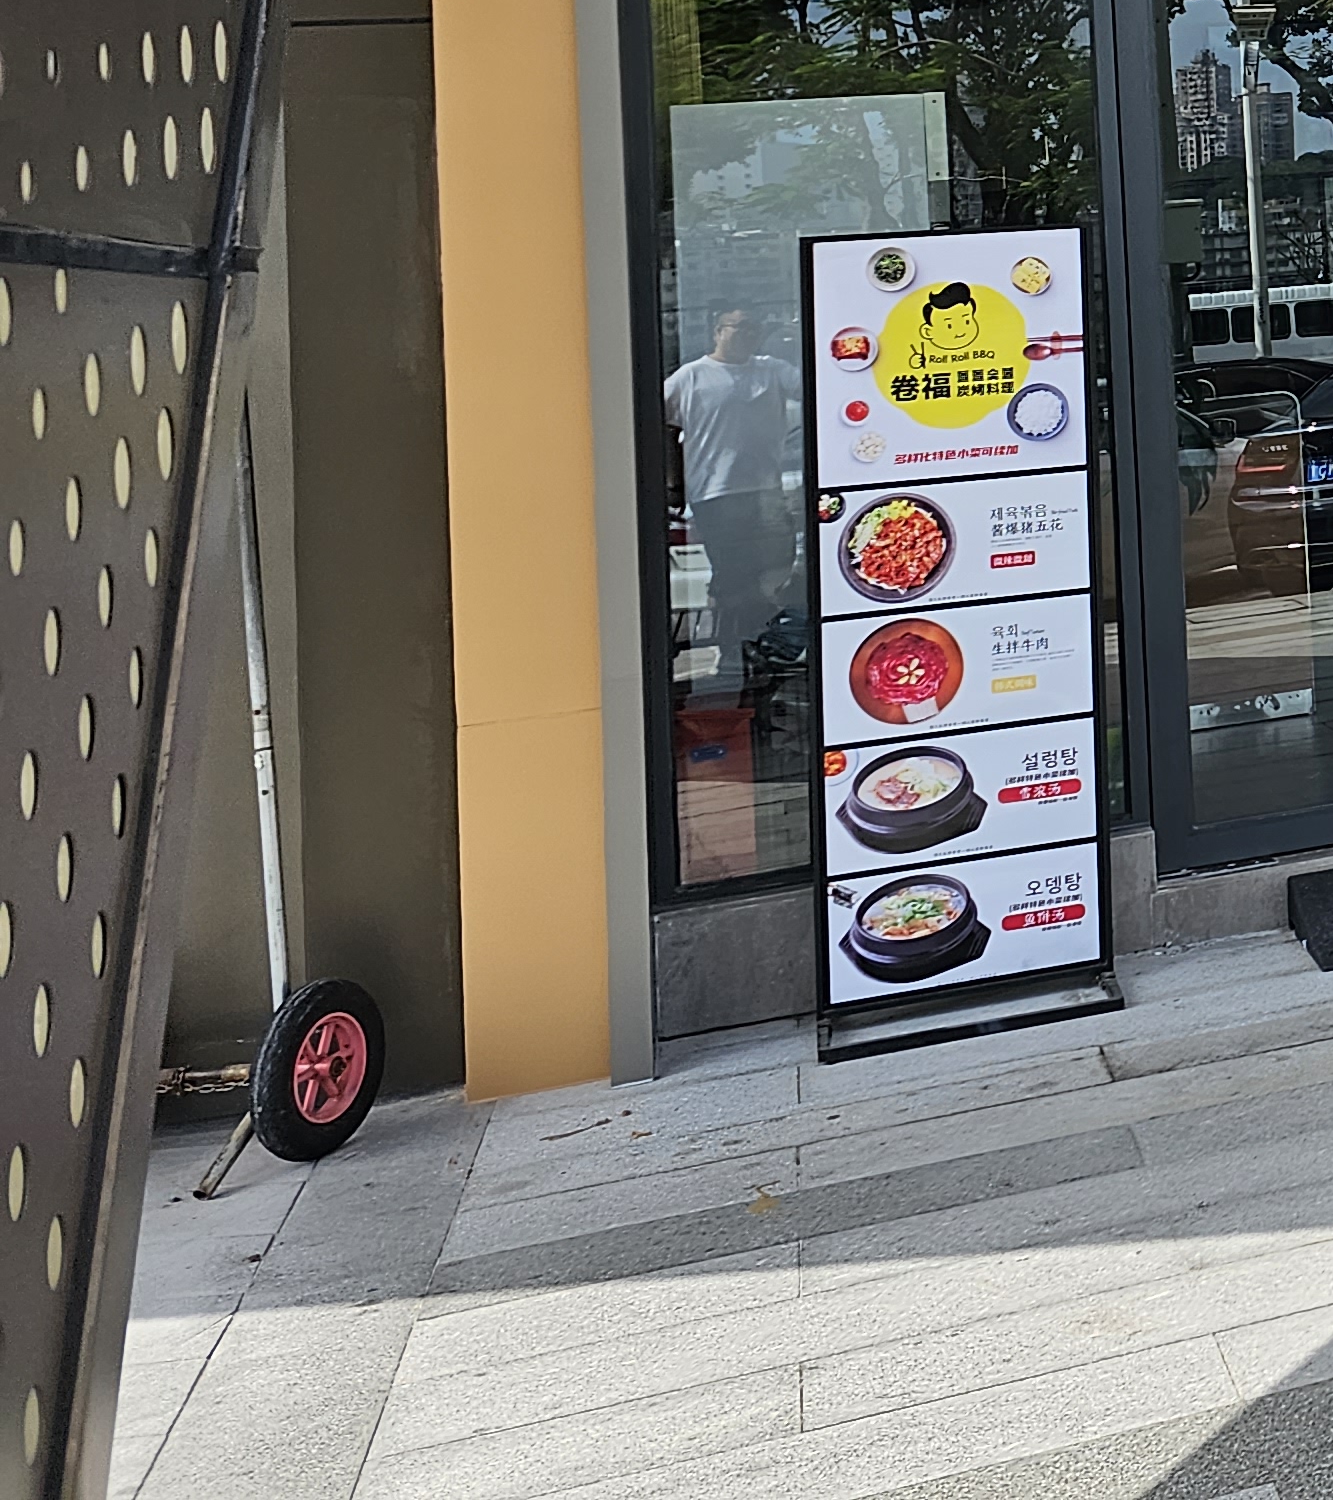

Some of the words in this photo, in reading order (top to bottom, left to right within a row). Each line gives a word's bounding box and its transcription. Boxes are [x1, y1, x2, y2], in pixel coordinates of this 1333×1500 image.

[929, 354, 948, 364] Roll
[951, 352, 969, 363] Roll
[973, 350, 995, 359] BBQ
[891, 372, 951, 402] 卷福
[992, 637, 1049, 656] 生拌牛肉
[1021, 747, 1079, 772] 설렁탕
[1025, 871, 1083, 897] 오뎅탕
